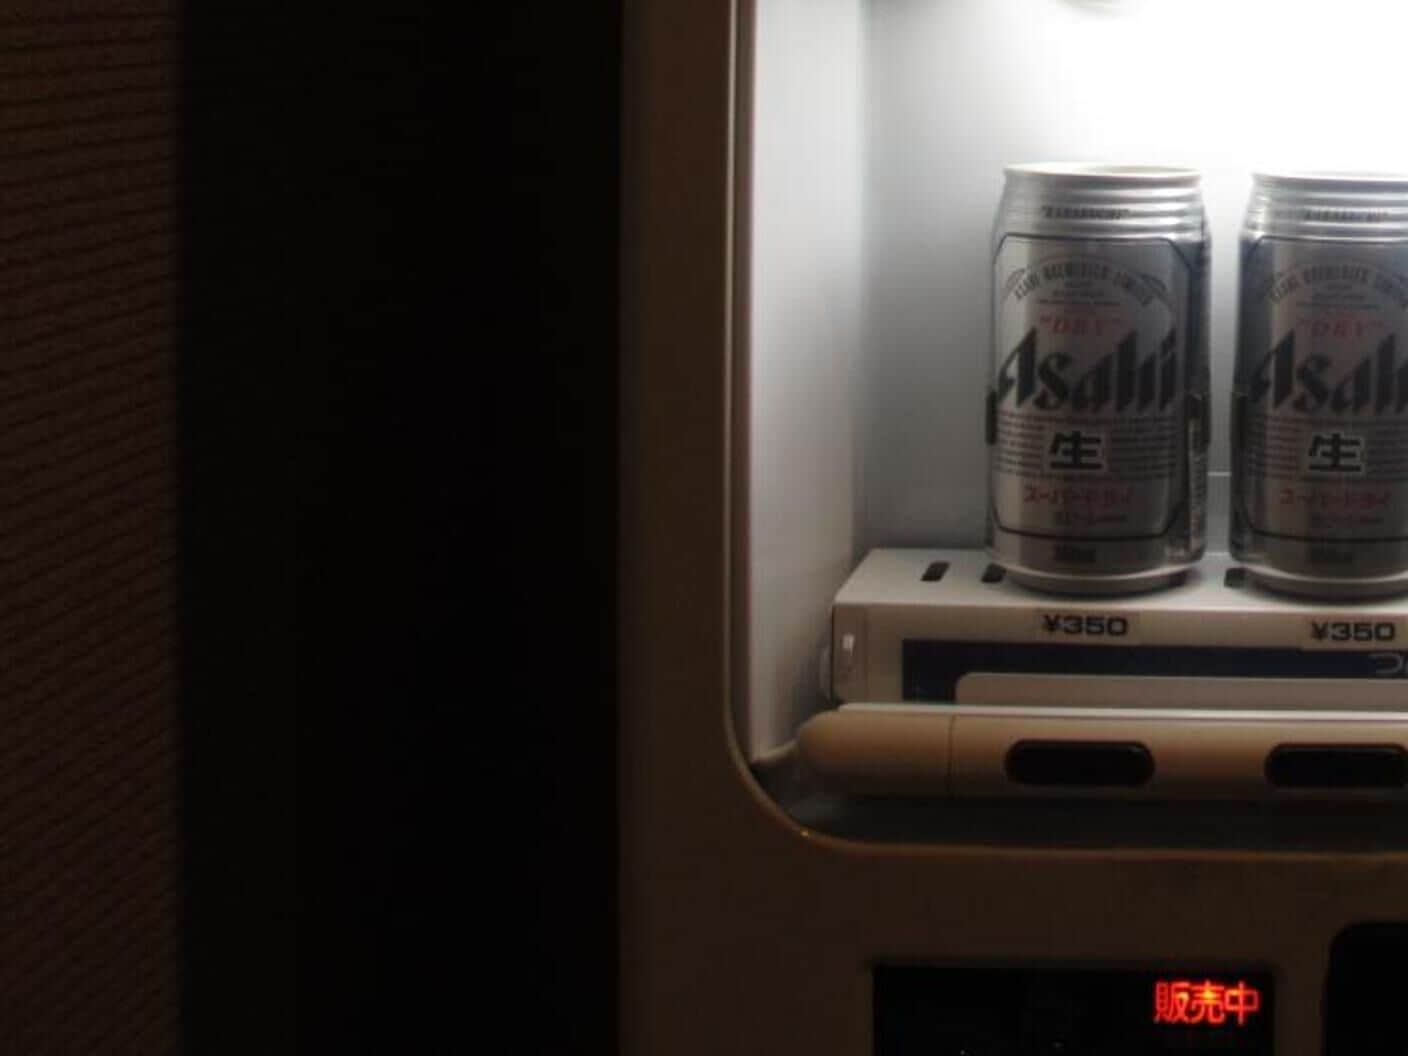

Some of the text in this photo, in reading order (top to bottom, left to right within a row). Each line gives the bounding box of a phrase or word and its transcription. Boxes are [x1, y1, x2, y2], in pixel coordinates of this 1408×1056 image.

[999, 328, 1178, 413] Asahi
[1049, 429, 1103, 470] 生
[1308, 433, 1362, 473] 生
[1043, 613, 1129, 637] ¥350
[1310, 621, 1396, 643] ¥350
[1152, 978, 1262, 1026] 販売中
